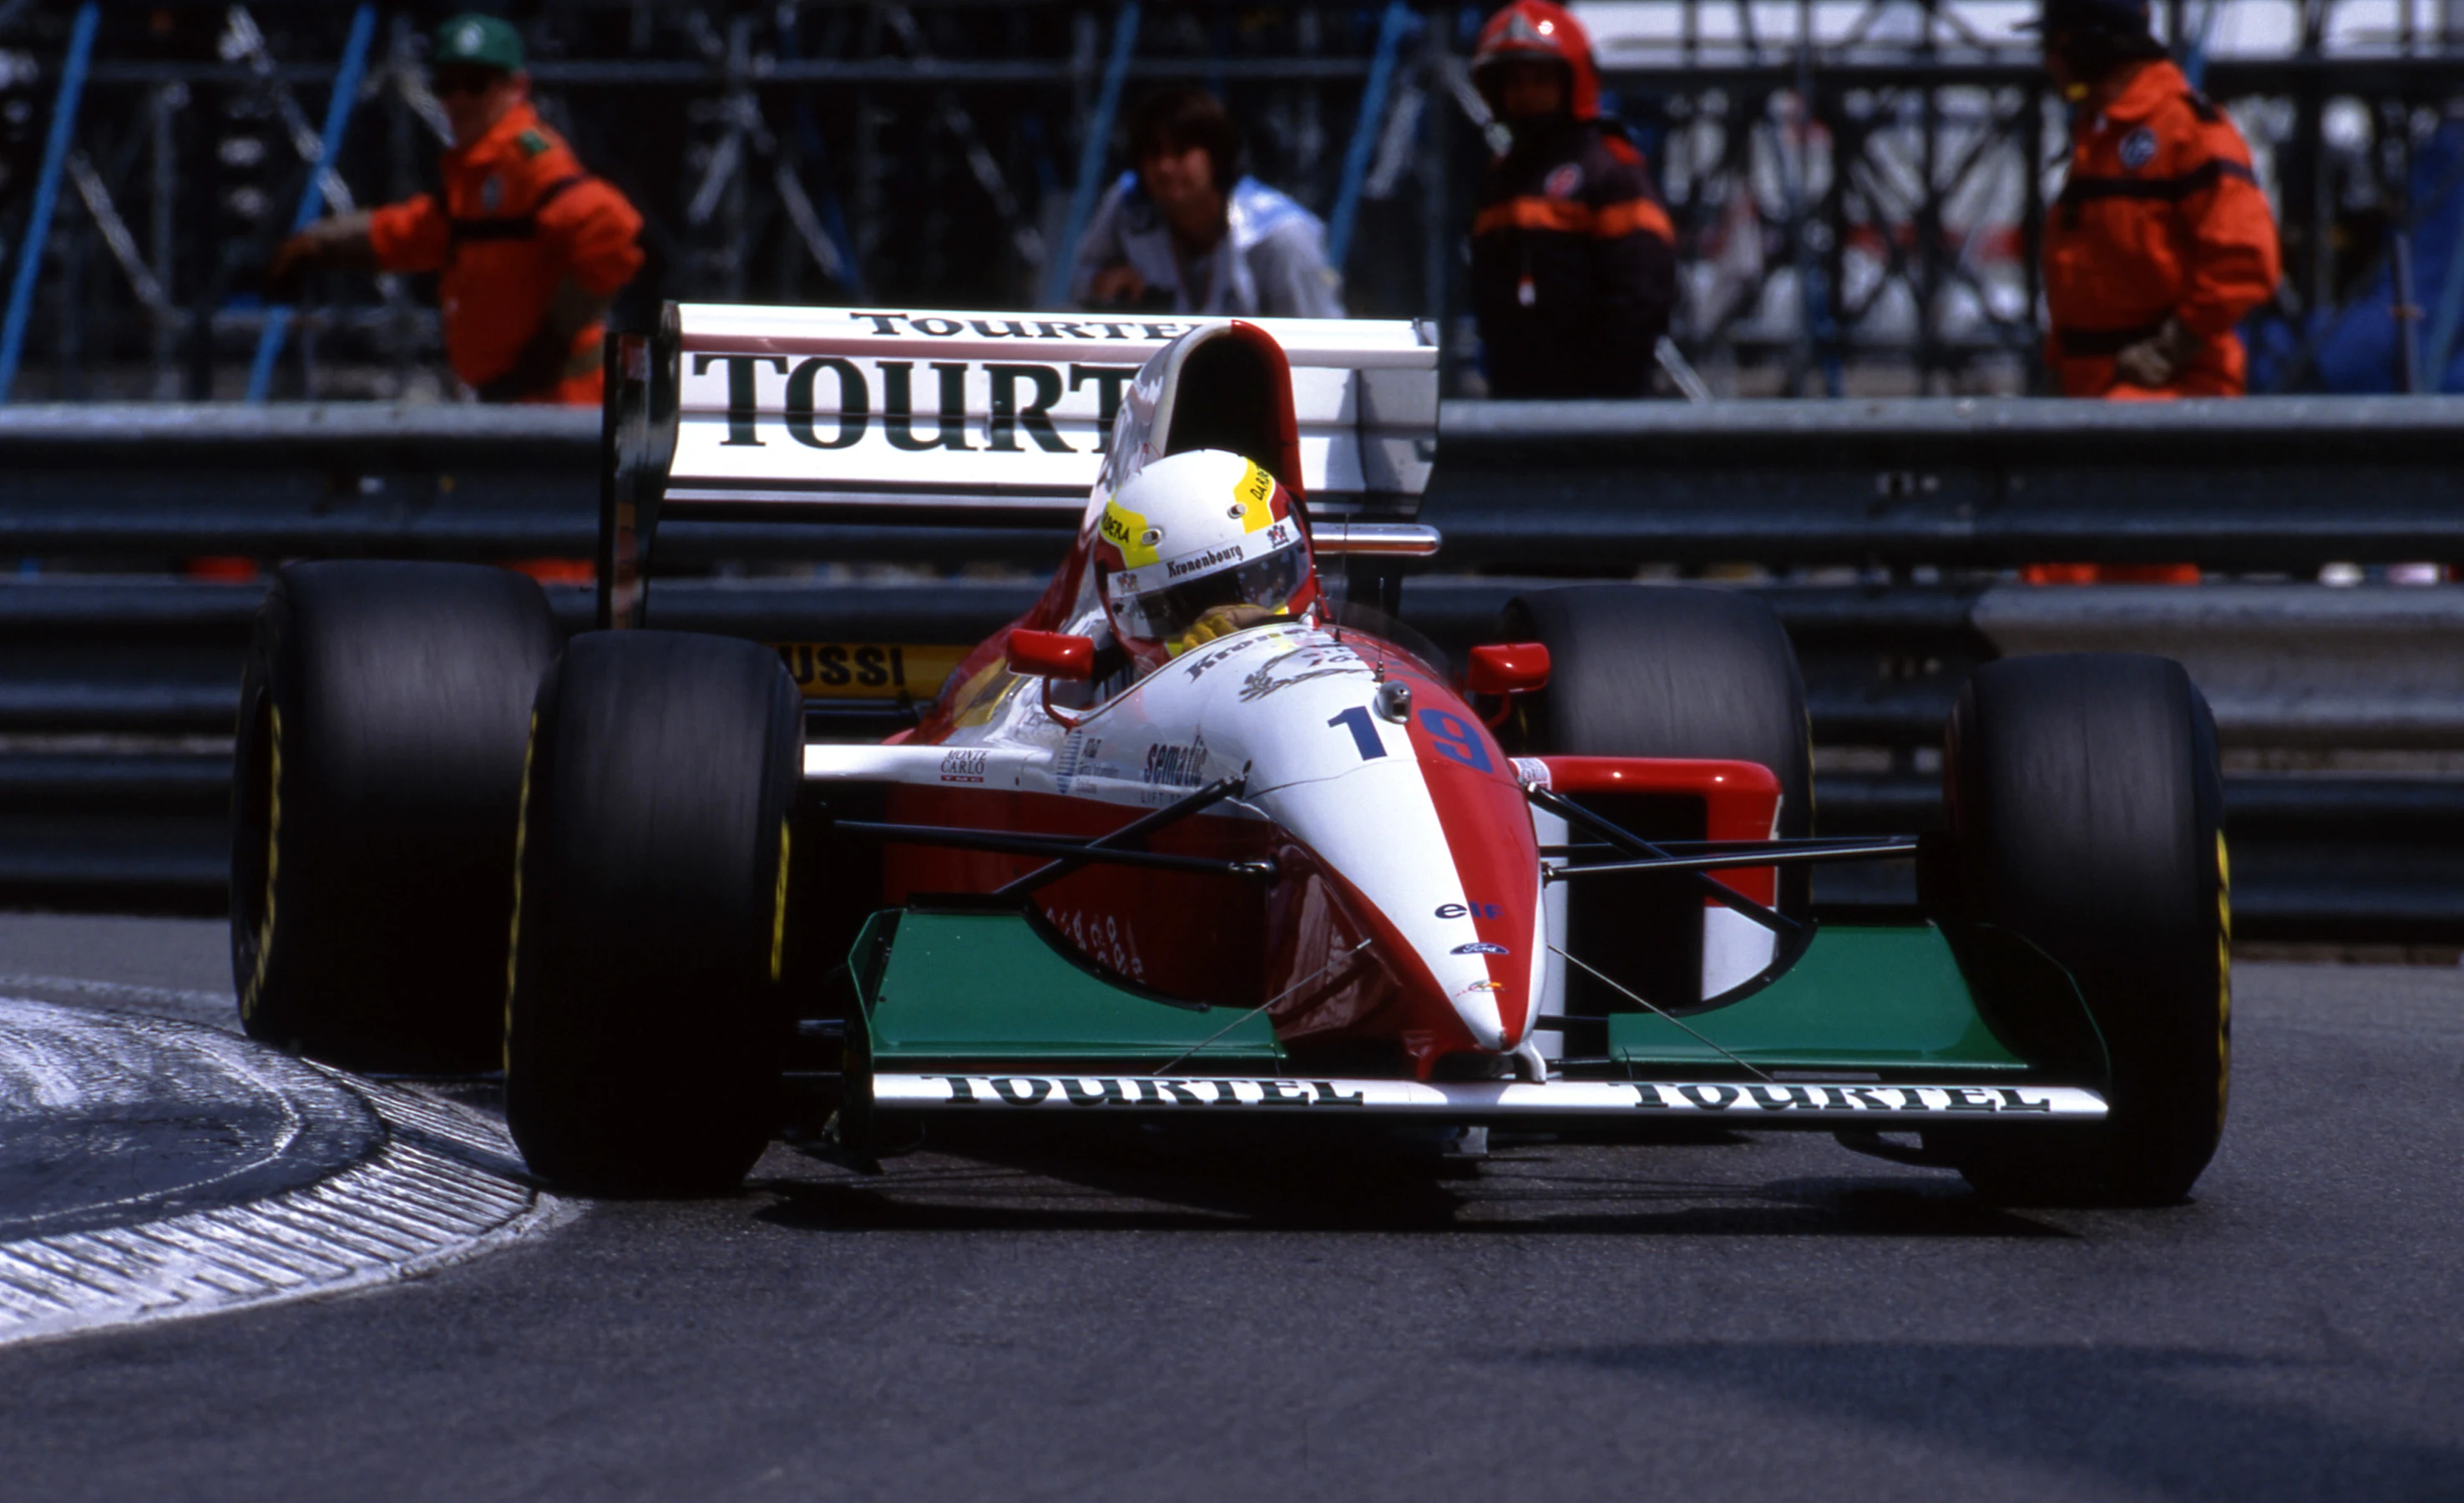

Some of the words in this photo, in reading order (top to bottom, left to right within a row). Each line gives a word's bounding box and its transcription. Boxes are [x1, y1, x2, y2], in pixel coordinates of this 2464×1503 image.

[849, 312, 1199, 338] TOURTE
[1166, 544, 1244, 579] Kronenbourg
[941, 759, 985, 775] CARLO
[944, 749, 991, 762] MONTE
[1462, 943, 1499, 954] Ford
[919, 1075, 1364, 1106] TOURTEL
[1608, 1082, 2051, 1112] TOURTEL
